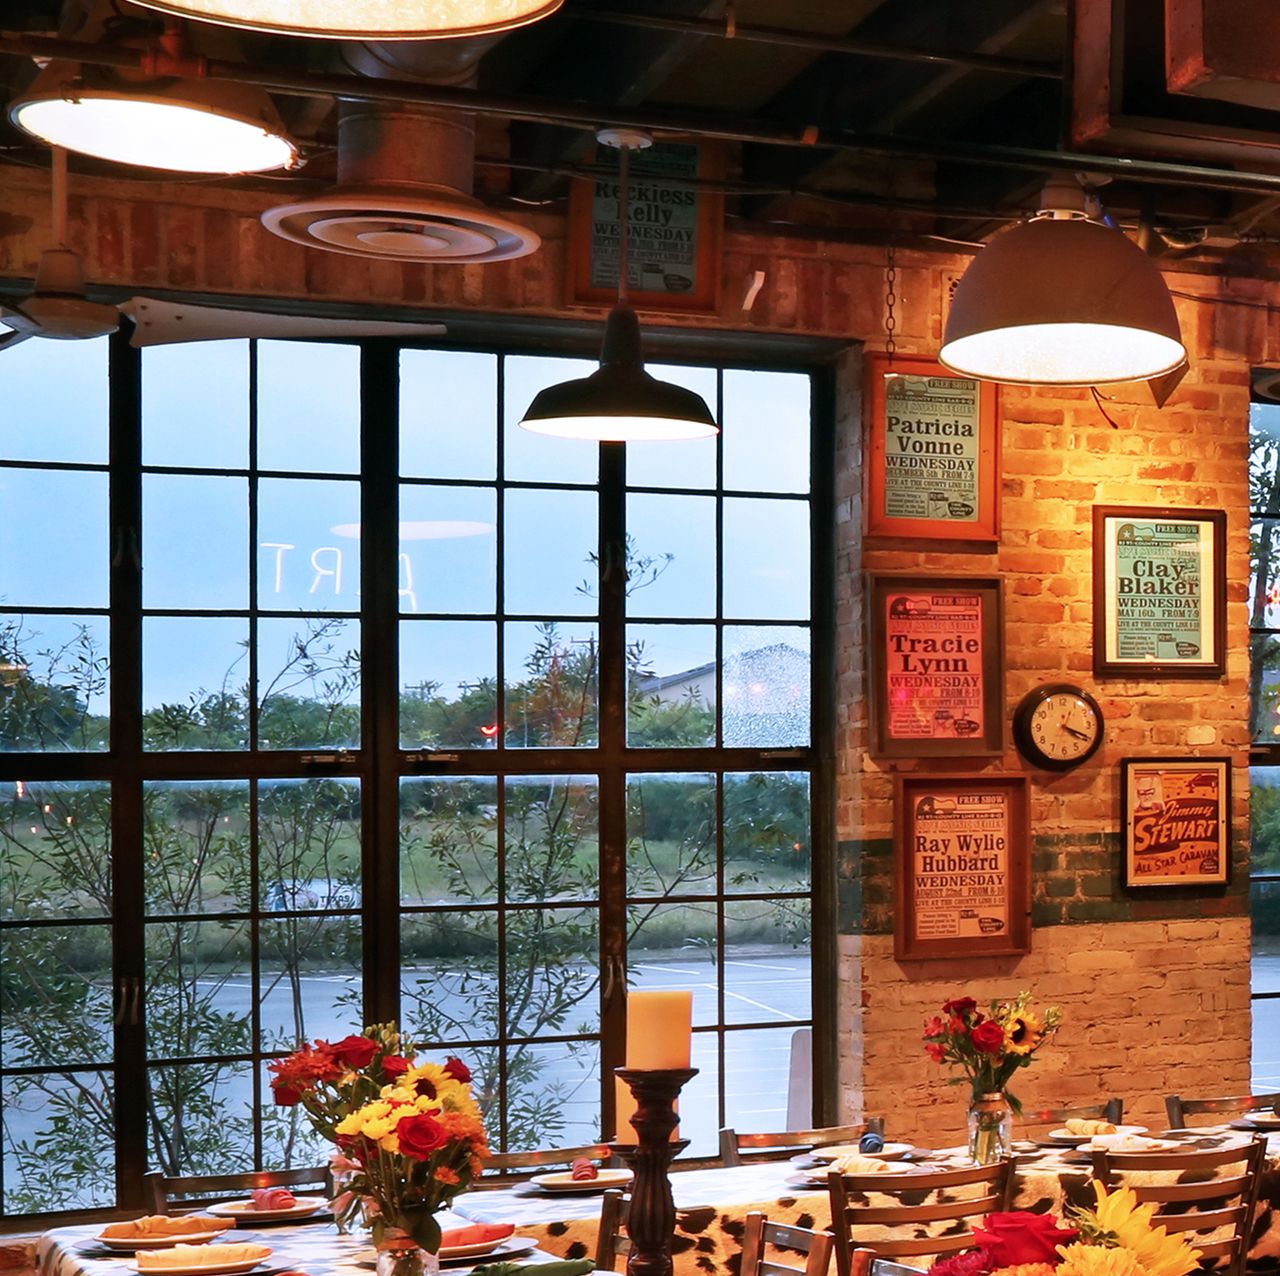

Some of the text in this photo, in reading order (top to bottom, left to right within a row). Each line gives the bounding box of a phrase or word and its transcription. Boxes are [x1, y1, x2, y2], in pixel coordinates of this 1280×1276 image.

[594, 223, 695, 242] WENESDAY
[886, 415, 975, 437] Patricia
[897, 435, 964, 455] Vonne
[886, 456, 975, 471] WEDNESDAY
[1132, 559, 1186, 581] Clay
[1118, 577, 1199, 595] Blaker
[1118, 598, 1200, 609] WEDNESDAY
[1118, 608, 1135, 618] MAY
[1138, 609, 1156, 618] 16th
[1162, 609, 1186, 618] FROM
[890, 634, 980, 654] Tracie
[901, 654, 969, 676] Lynn
[890, 676, 980, 687] WEDNESDAY
[1059, 698, 1067, 706] 12
[1035, 723, 1042, 732] 9
[1085, 720, 1092, 730] 3
[1040, 735, 1046, 744] 8
[1050, 743, 1056, 752] 7
[1061, 746, 1068, 755] 6
[1073, 742, 1079, 752] 5
[1158, 800, 1214, 825] Jimmy
[915, 833, 1005, 855] Ray Wylie
[922, 854, 999, 873] Hubbard
[1134, 847, 1219, 874] ALL STAR CARAVAN
[916, 874, 1004, 888] WEDNESDAY
[968, 887, 989, 896] FROM
